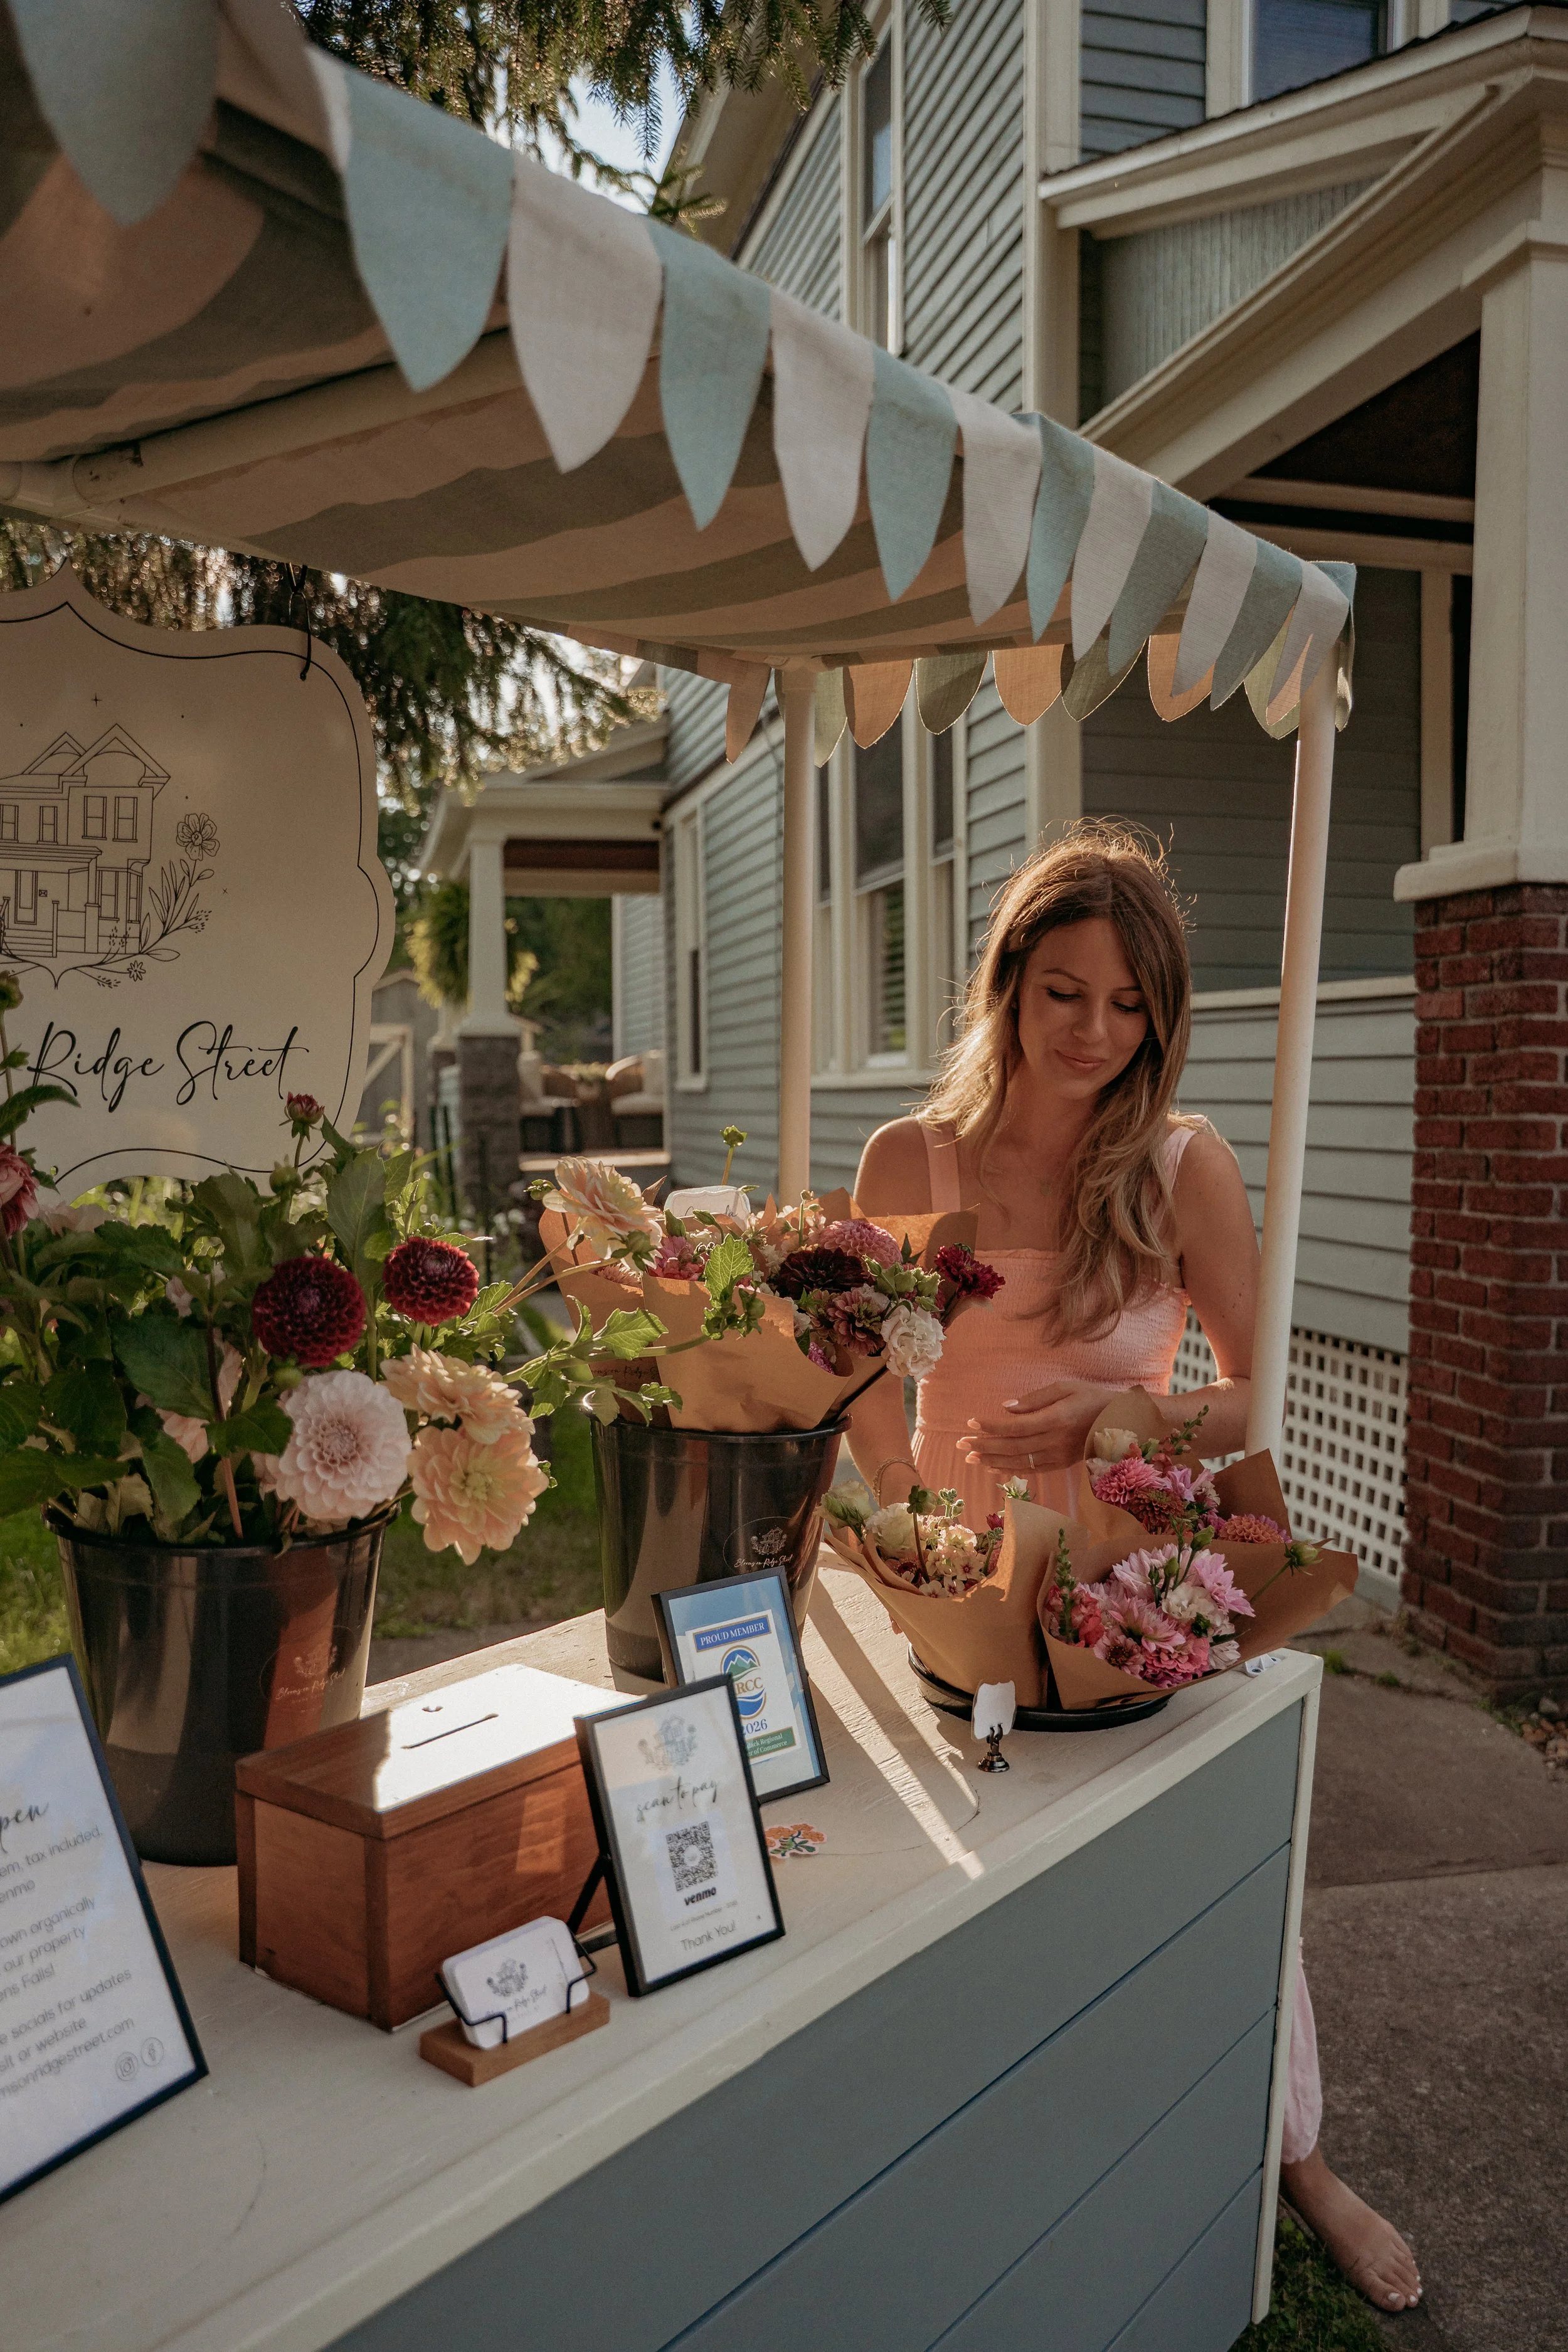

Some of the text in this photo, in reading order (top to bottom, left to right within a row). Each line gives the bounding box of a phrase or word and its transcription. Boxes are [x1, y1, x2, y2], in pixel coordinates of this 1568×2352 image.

[27, 1020, 309, 1113] Ridge Street
[762, 1557, 778, 1568] Ridge
[700, 1622, 765, 1646] PROUD MEMBER
[735, 1677, 763, 1695] RCC
[760, 1733, 783, 1744] Regional
[760, 1740, 788, 1752] Commerce
[637, 1776, 719, 1822] scan to pay
[25, 1849, 48, 1866] tax
[684, 1887, 717, 1906] venmo
[30, 1896, 95, 1933] organically
[4, 1926, 86, 1972] our property
[681, 1919, 736, 1951] Thank You!
[11, 1968, 132, 2040] socials for updates
[18, 2046, 31, 2062] or
[35, 2016, 87, 2051] website
